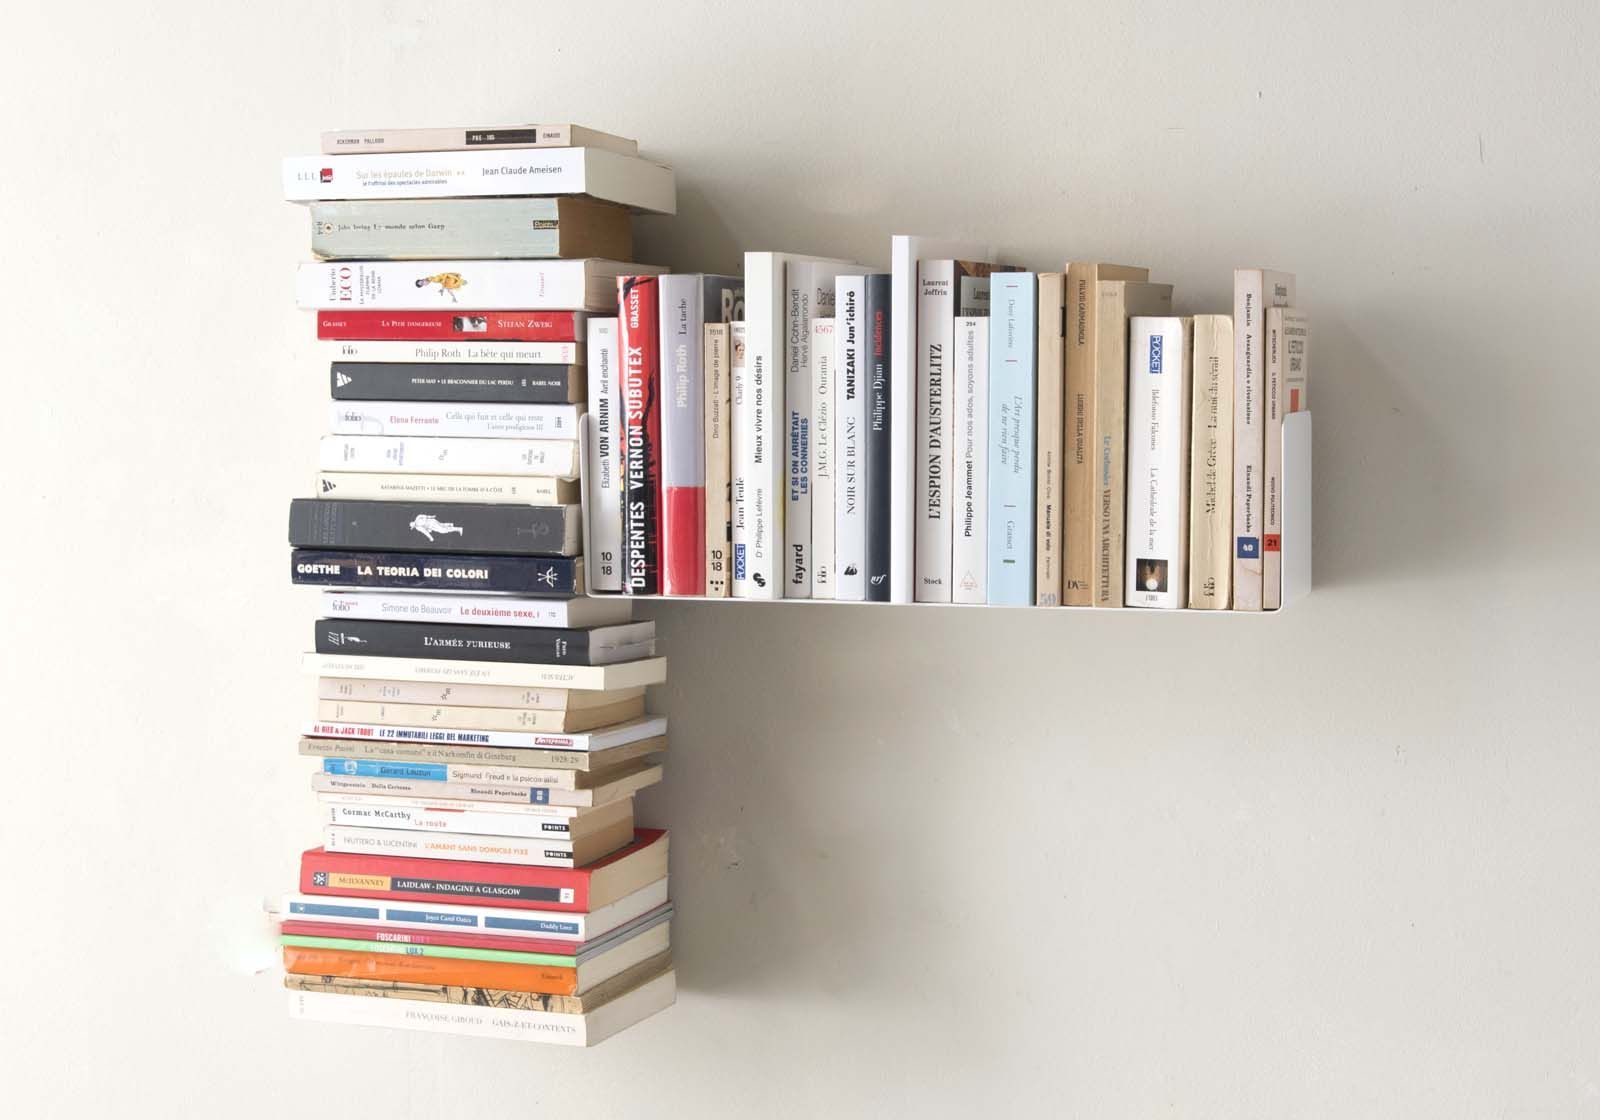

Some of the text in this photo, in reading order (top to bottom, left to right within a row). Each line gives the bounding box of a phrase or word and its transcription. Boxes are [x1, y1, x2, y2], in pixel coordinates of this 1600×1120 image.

[415, 168, 425, 178] de
[482, 165, 563, 177] Jean Claude Ameisen
[339, 267, 353, 302] ECO
[630, 287, 640, 329] GRASSET
[1244, 293, 1253, 327] Benjamin
[677, 325, 688, 336] La
[790, 289, 801, 374] Daniel Cohn-Bendit
[415, 348, 461, 360] Philip Roth
[468, 348, 479, 358] La
[500, 349, 515, 360] qui
[516, 350, 542, 359] meurt
[600, 348, 610, 379] enchanté
[674, 343, 688, 373] Roth
[800, 344, 809, 368] Hervé
[1150, 335, 1163, 375] POCKET
[1244, 334, 1253, 379] Avanguardia
[600, 380, 610, 395] Avril
[872, 362, 886, 390] Djian
[675, 374, 690, 409] Philip
[845, 290, 857, 514] NOIR SUR BLANC TANIZAKI Jun'ichirô
[390, 415, 410, 425] Elena
[599, 398, 610, 434] ARNIM
[816, 355, 829, 478] J.M.G. Le Clézio Ourania
[872, 391, 886, 432] Philippe
[928, 343, 943, 520] L'ESPION D'AUSTERLITZ
[964, 330, 976, 538] Philippe Jeammet Pour nos ados, soyons adultes
[599, 436, 610, 458] VON
[753, 355, 765, 548] Philippe Lefèvre Mieux vivre nos désirs
[790, 410, 800, 502] ET SI ON ARRÊTAIT
[800, 417, 809, 495] LES CONNERIES
[600, 460, 611, 489] Elizabeth
[628, 346, 646, 588] DESPENTES VERNON SUBUTEX
[734, 386, 746, 581] POCKET Jean Teulé Charly
[1102, 488, 1112, 519] VERSO
[1244, 493, 1253, 534] Paperbacks
[1101, 519, 1111, 535] UNA
[1266, 538, 1278, 548] 21
[601, 551, 613, 562] 10
[711, 550, 723, 560] 10
[711, 561, 723, 571] 18
[791, 544, 806, 585] fayard
[297, 563, 341, 576] GOETHE
[357, 565, 489, 581] LA TEORIA DEI COLORI
[601, 565, 613, 577] 18
[1100, 534, 1112, 603] ARCHITETTURA
[382, 603, 409, 614] Simone
[410, 604, 419, 614] de
[460, 607, 512, 619] Le deuxième
[340, 727, 356, 737] JACK
[379, 728, 387, 737] LE
[387, 728, 396, 738] 22
[429, 731, 446, 741] LEGGI
[446, 732, 457, 741] DEL
[457, 732, 491, 744] MARKETING
[342, 807, 411, 820] Cormac McCarthy
[413, 818, 448, 828] La route
[543, 824, 567, 832] POINTS
[545, 851, 568, 859] POINTS
[397, 880, 431, 892] LAIDLAW
[435, 883, 475, 894] INDAGINE
[481, 886, 521, 897] GLASGOW
[376, 931, 411, 944] FOSCARINI
[405, 945, 417, 956] LUX
